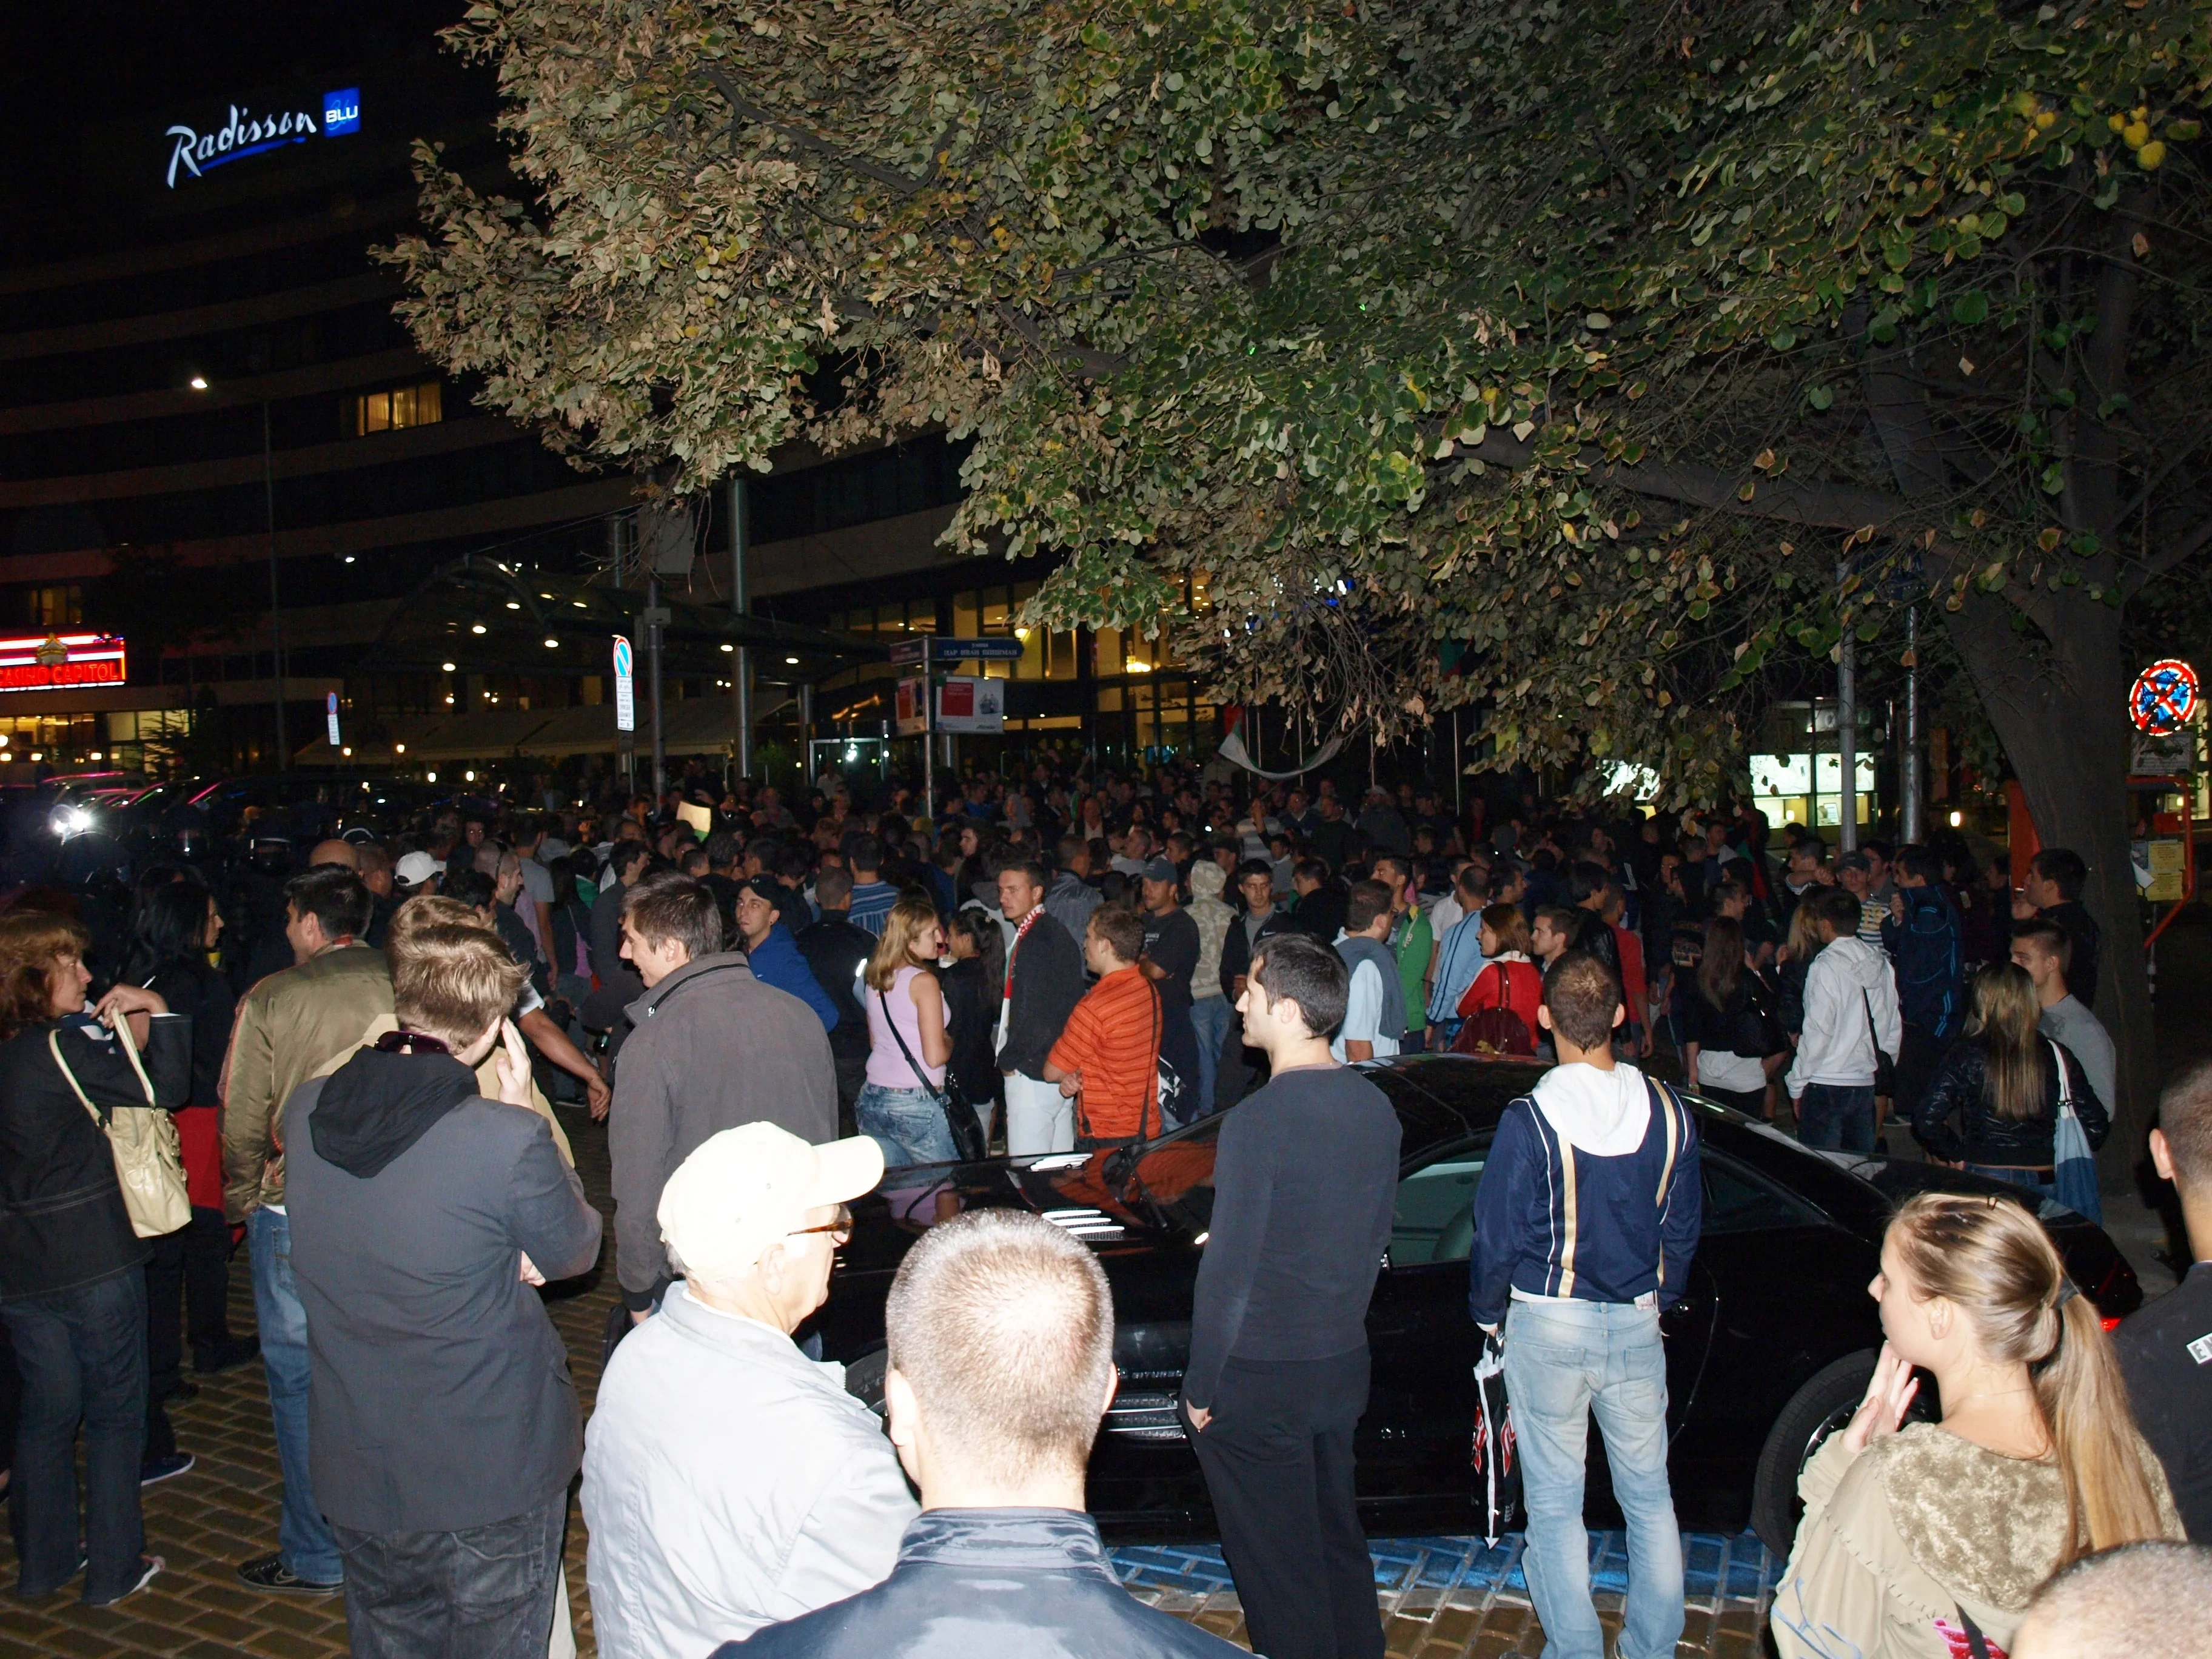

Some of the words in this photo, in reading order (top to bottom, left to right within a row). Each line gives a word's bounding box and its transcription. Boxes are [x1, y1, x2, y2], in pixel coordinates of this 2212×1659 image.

[165, 104, 317, 189] Radisson
[325, 105, 359, 124] BLU
[52, 662, 118, 683] CAPITOL
